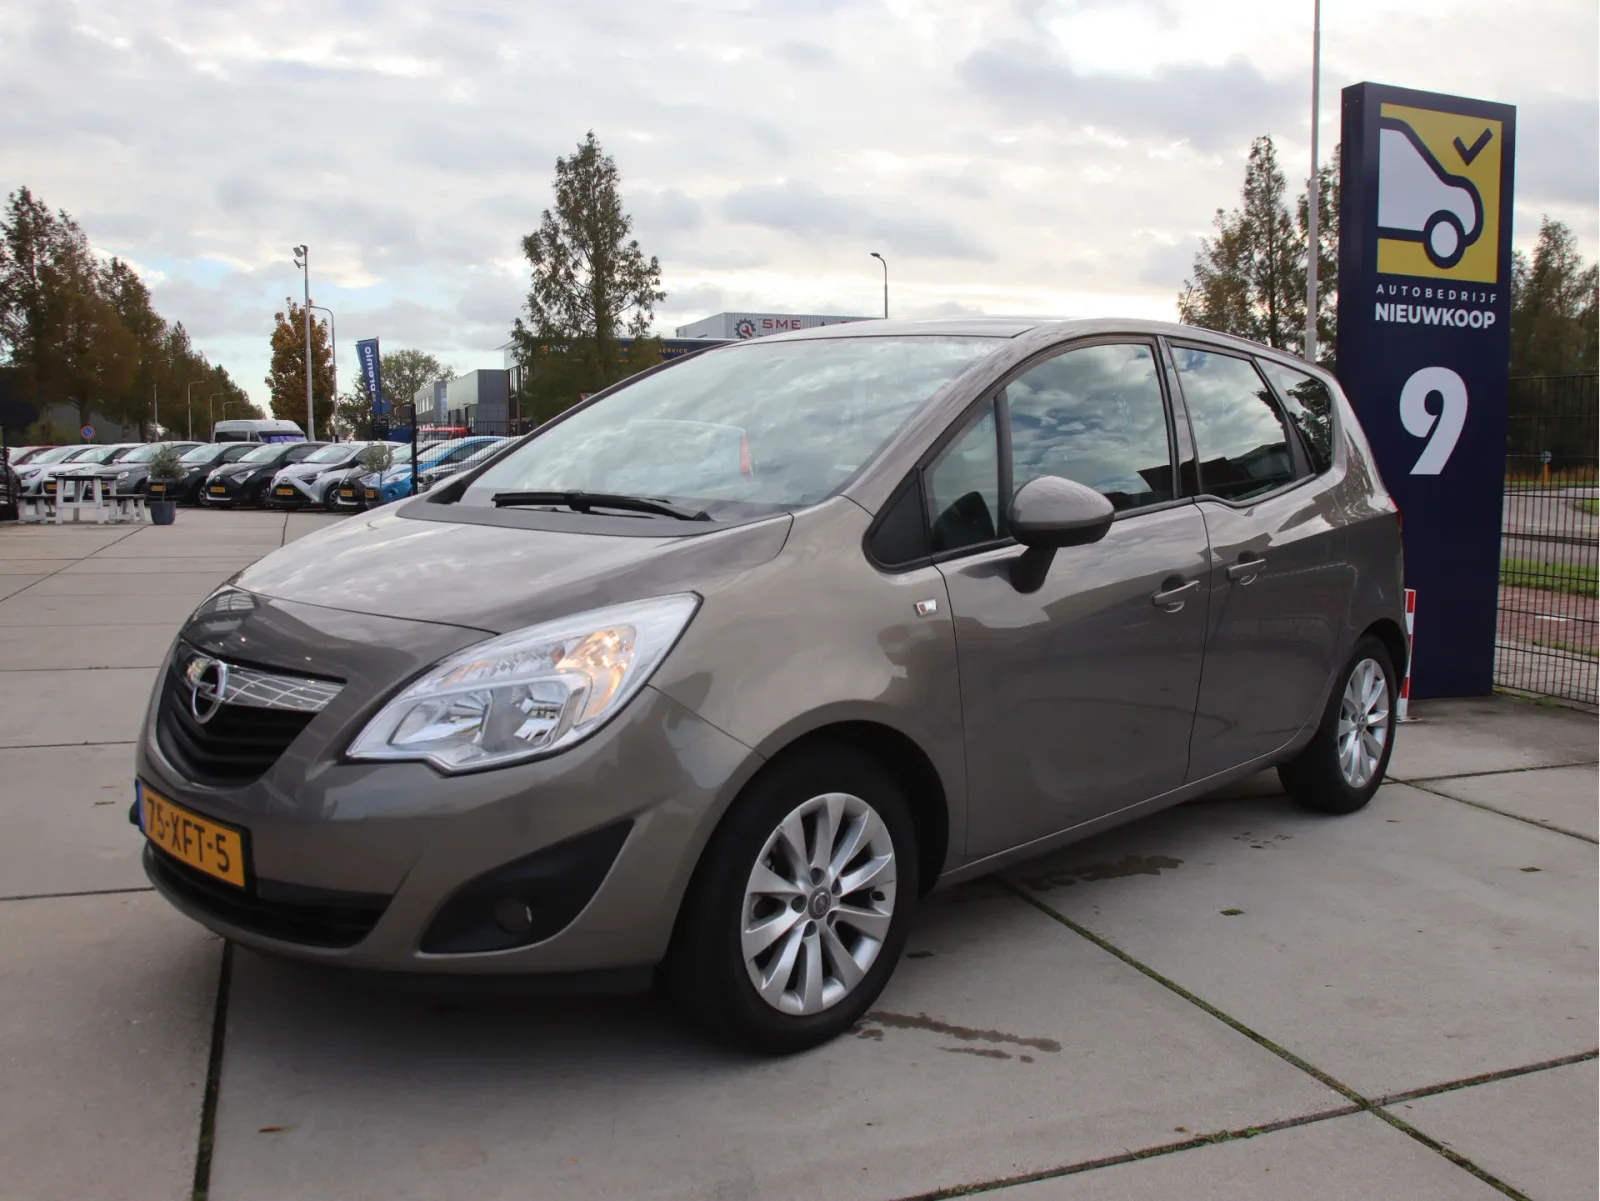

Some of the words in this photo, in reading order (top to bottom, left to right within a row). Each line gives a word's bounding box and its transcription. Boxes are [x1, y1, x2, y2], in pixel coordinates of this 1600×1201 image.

[1376, 283, 1497, 304] AUTOBEDRIJF
[762, 318, 801, 330] SME
[1374, 302, 1496, 329] NIEUWKOOP
[1399, 366, 1468, 475] 9
[146, 797, 230, 873] 75-XFT-5
